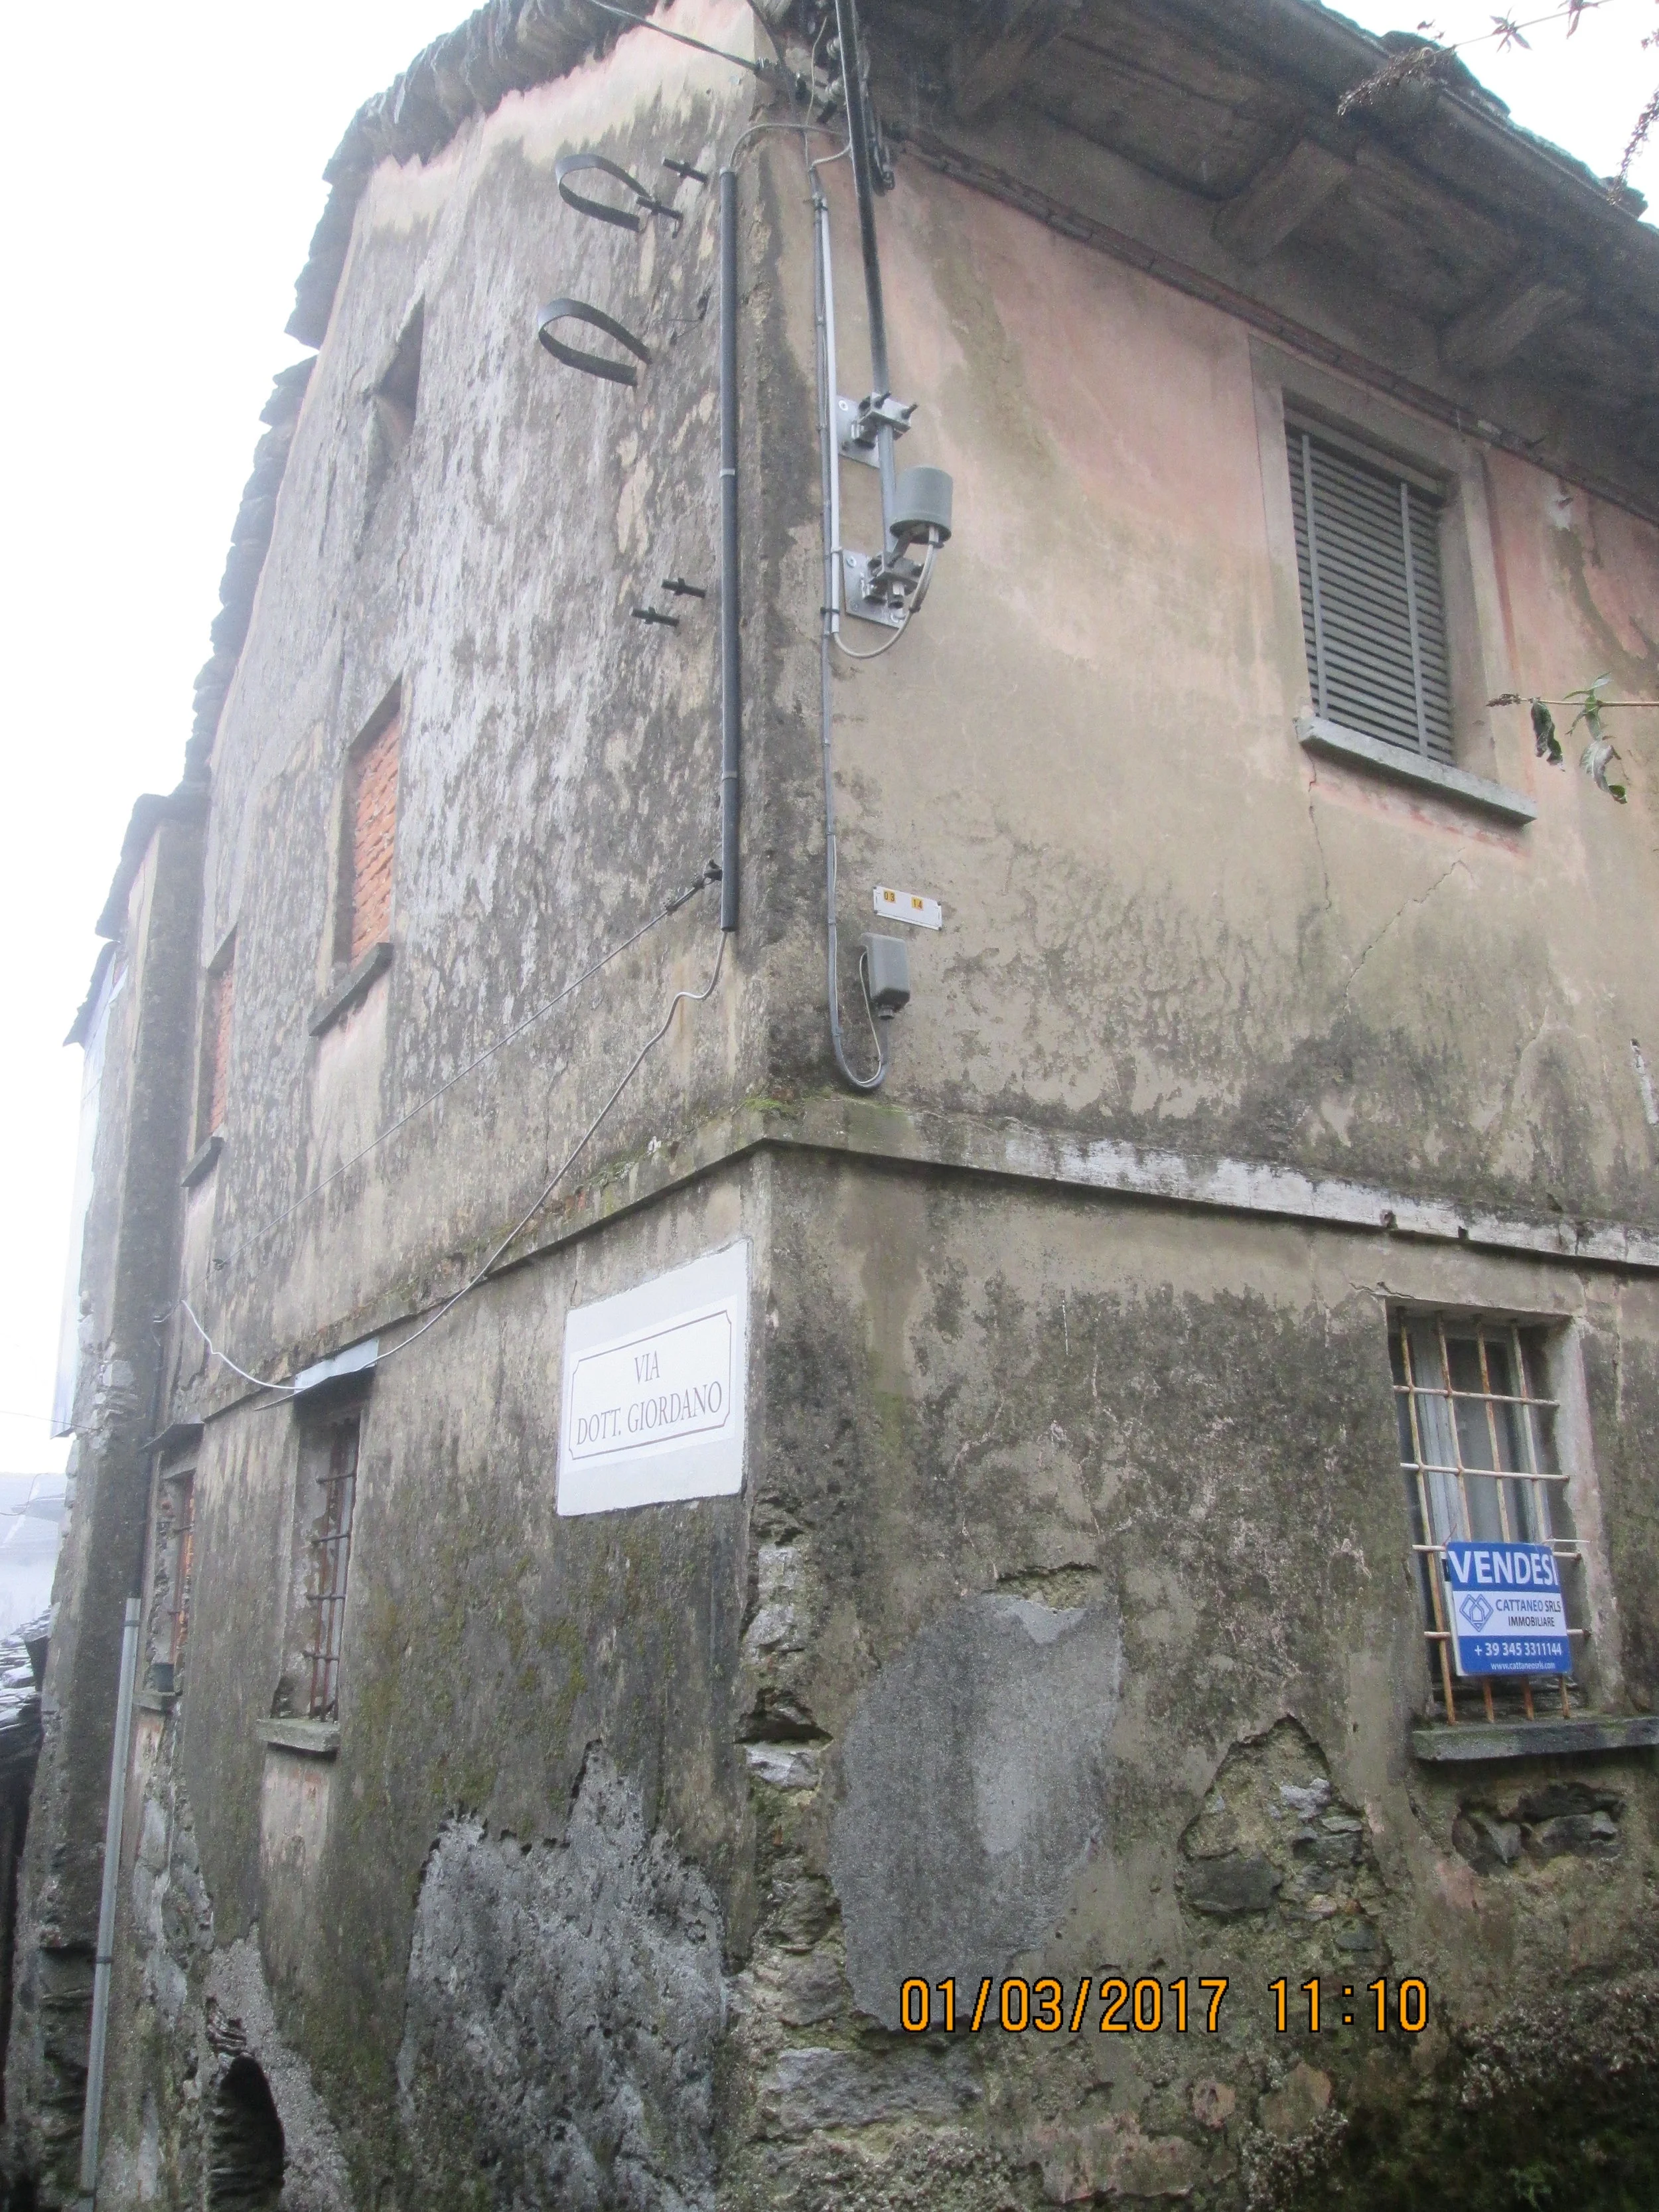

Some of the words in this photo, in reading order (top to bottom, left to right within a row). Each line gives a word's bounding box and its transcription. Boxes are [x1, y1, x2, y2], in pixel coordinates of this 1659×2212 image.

[634, 1350, 661, 1384] VIA
[576, 1407, 622, 1445] DOTT.
[627, 1381, 723, 1433] GIORDANO
[1448, 1550, 1559, 1585] VENDESI
[1495, 1599, 1544, 1611] CATTANEO
[1544, 1600, 1561, 1613] SRLS
[1508, 1616, 1555, 1627] IMMOBILIARE
[1485, 1643, 1500, 1656] 39
[1502, 1643, 1522, 1656] 345
[1524, 1643, 1562, 1656] 3311144
[1490, 1661, 1555, 1670] www.cattaneosrls.com
